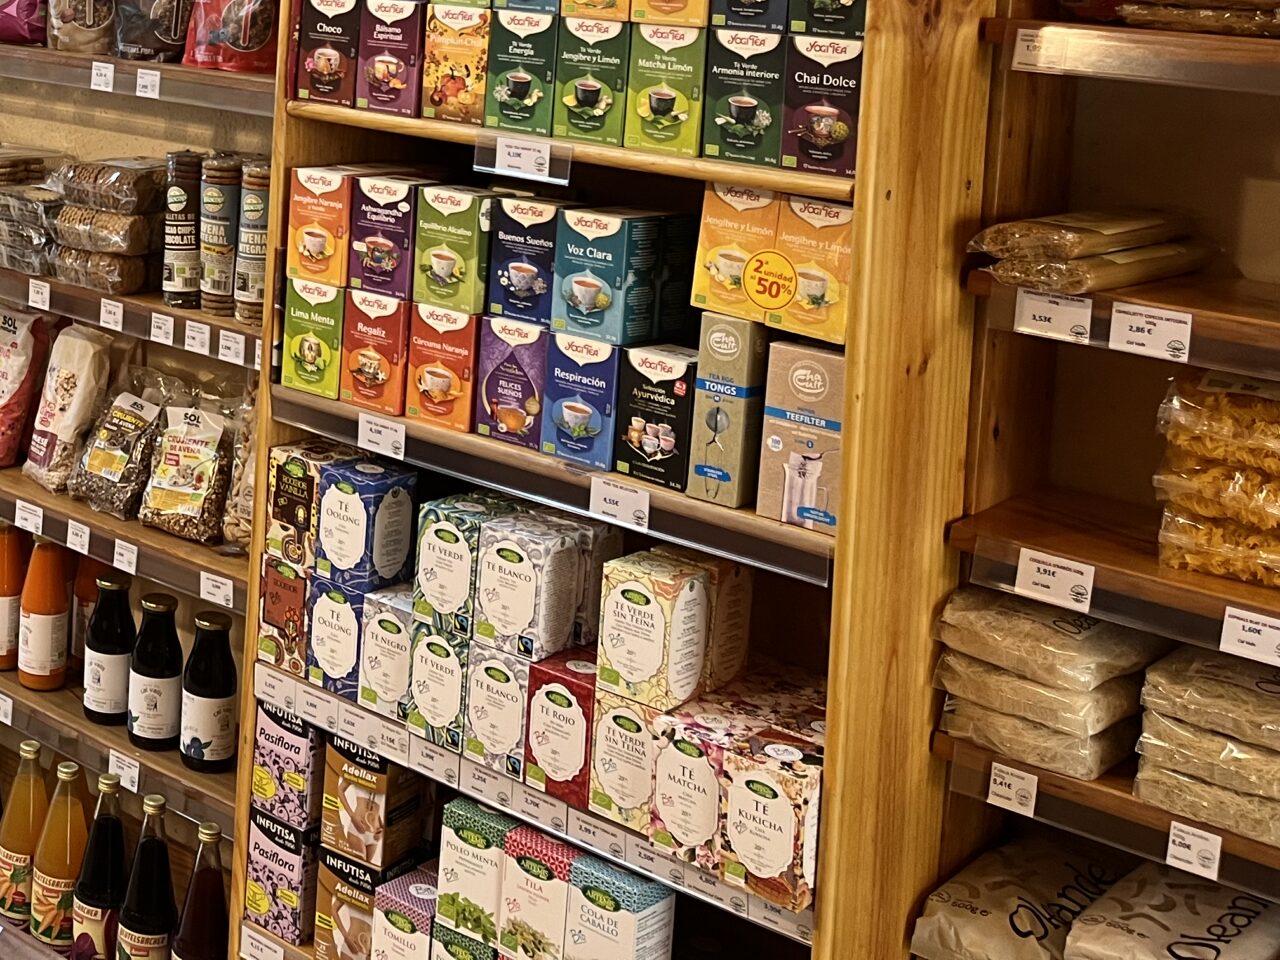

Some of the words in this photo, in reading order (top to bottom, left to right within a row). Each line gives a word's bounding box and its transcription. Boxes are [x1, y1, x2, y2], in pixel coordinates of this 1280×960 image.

[317, 23, 342, 34] Choco
[562, 52, 589, 63] Jengibre
[597, 54, 620, 65] Limón
[638, 59, 666, 70] Matcha
[668, 61, 693, 73] Limón
[795, 71, 820, 84] Chai
[823, 73, 856, 88] Dolce
[498, 231, 524, 243] Buenos
[526, 235, 553, 248] Sueños
[567, 243, 585, 256] Voz
[586, 246, 612, 261] Clara
[764, 269, 793, 283] unidad
[755, 277, 792, 299] 50%
[1, 314, 18, 330] SOL
[291, 308, 309, 319] Lima
[311, 313, 334, 326] Menta
[357, 322, 386, 338] Regaliz
[1128, 325, 1145, 335] 2,86
[1146, 327, 1152, 335] €
[554, 368, 606, 389] Respiración
[632, 388, 675, 405] Ayurvédica
[705, 381, 737, 396] TONGS
[183, 412, 201, 424] SOL
[786, 411, 826, 427] TEEFILTER
[338, 500, 350, 511] TÉ
[326, 508, 360, 527] OOLONG
[427, 543, 436, 552] TÉ
[439, 546, 464, 561] VERDE
[486, 561, 495, 571] TÉ
[498, 565, 532, 583] BLANCO
[1036, 566, 1056, 578] 3,91€
[613, 610, 626, 620] SIN
[614, 601, 626, 611] TÉ
[627, 606, 654, 620] VERDE
[1241, 624, 1262, 636] 1,60€
[370, 631, 379, 640] TÉ
[381, 635, 407, 652] NEGRO
[540, 705, 550, 716] TÉ
[553, 710, 575, 727] ROJO
[259, 727, 301, 756] Pasiflora
[342, 763, 377, 783] Adellax
[680, 765, 695, 780] TÉ
[668, 774, 707, 796] MATCHA
[752, 799, 769, 816] TÉ
[256, 814, 296, 842] INFUTISA
[738, 808, 783, 834] KUKICHA
[253, 842, 295, 873] Pasiflora
[446, 841, 470, 858] POLEO
[472, 850, 499, 868] MENTA
[326, 854, 372, 884] INFUTISA
[335, 882, 369, 905] Adellax
[524, 877, 543, 893] TILA
[581, 904, 605, 922] COLA
[607, 917, 618, 929] DE
[951, 901, 979, 917] 500g
[580, 914, 619, 937] CABALLO
[383, 926, 416, 952] TOMILLO
